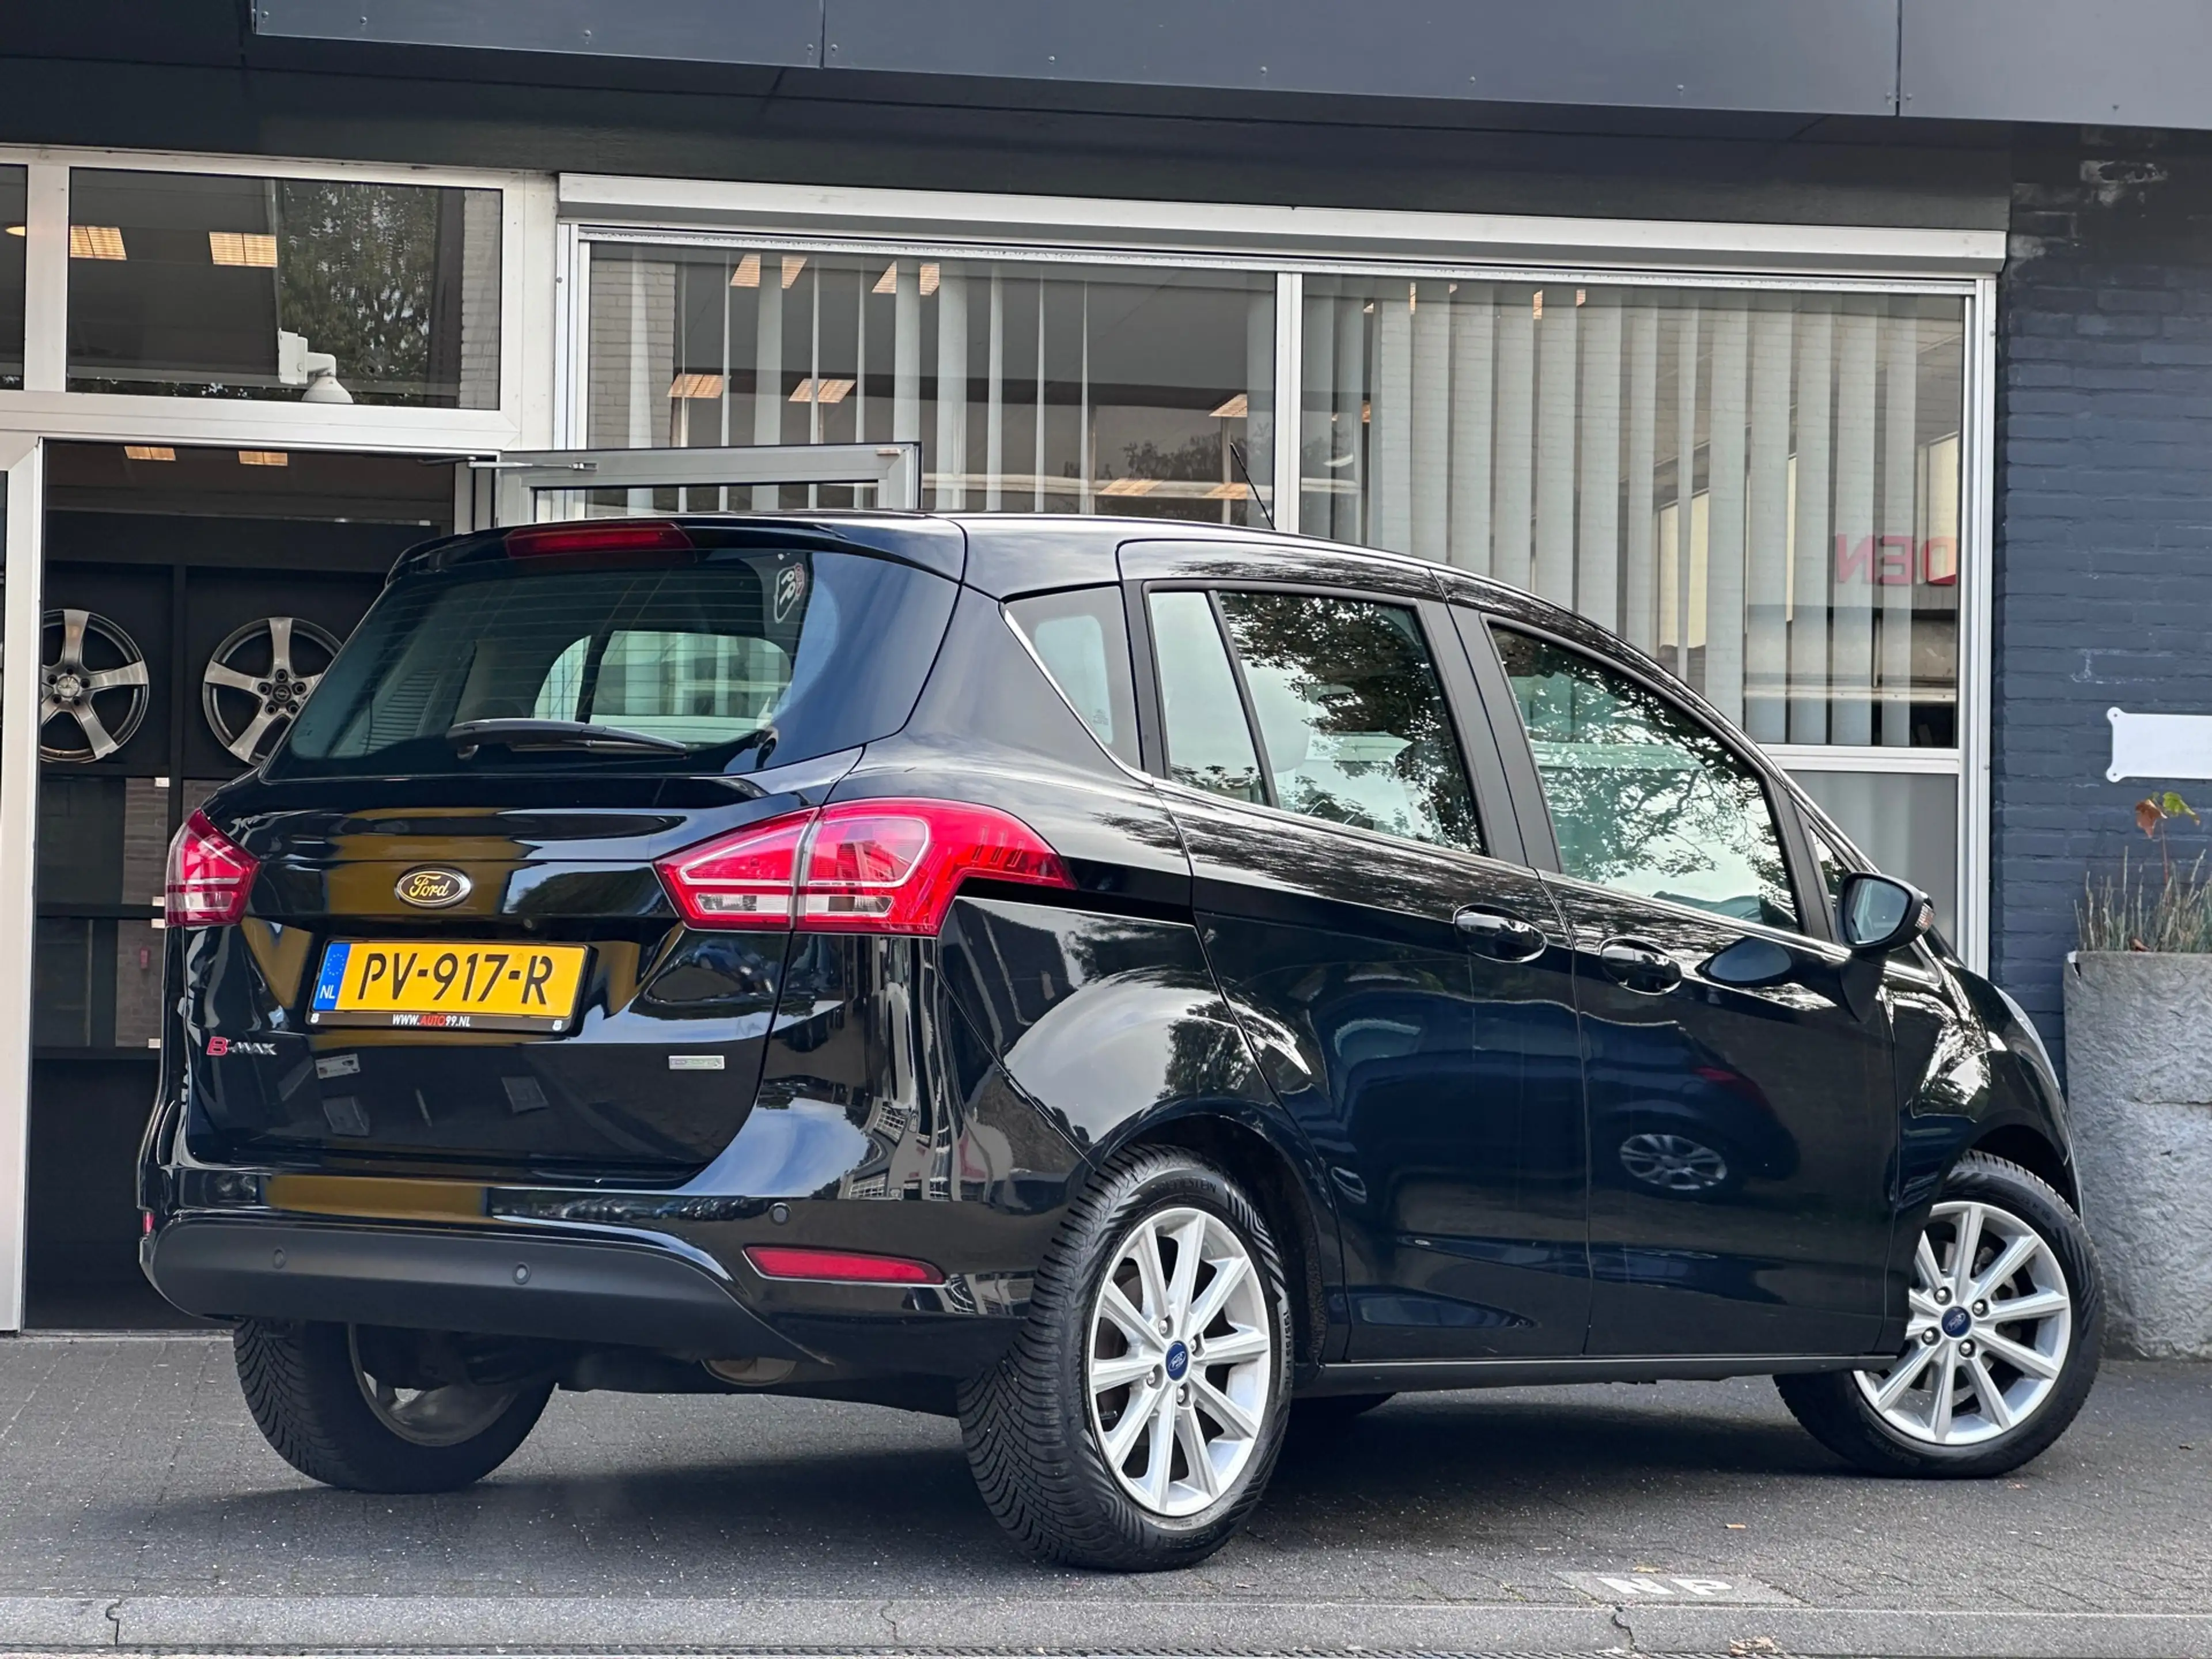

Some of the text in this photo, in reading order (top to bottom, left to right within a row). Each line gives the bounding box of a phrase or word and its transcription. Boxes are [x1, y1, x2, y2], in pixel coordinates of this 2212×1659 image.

[409, 874, 450, 897] Ford
[358, 953, 553, 1005] PV-917-R
[320, 984, 335, 999] NL
[393, 1014, 471, 1027] WWW.AUTO99.NL
